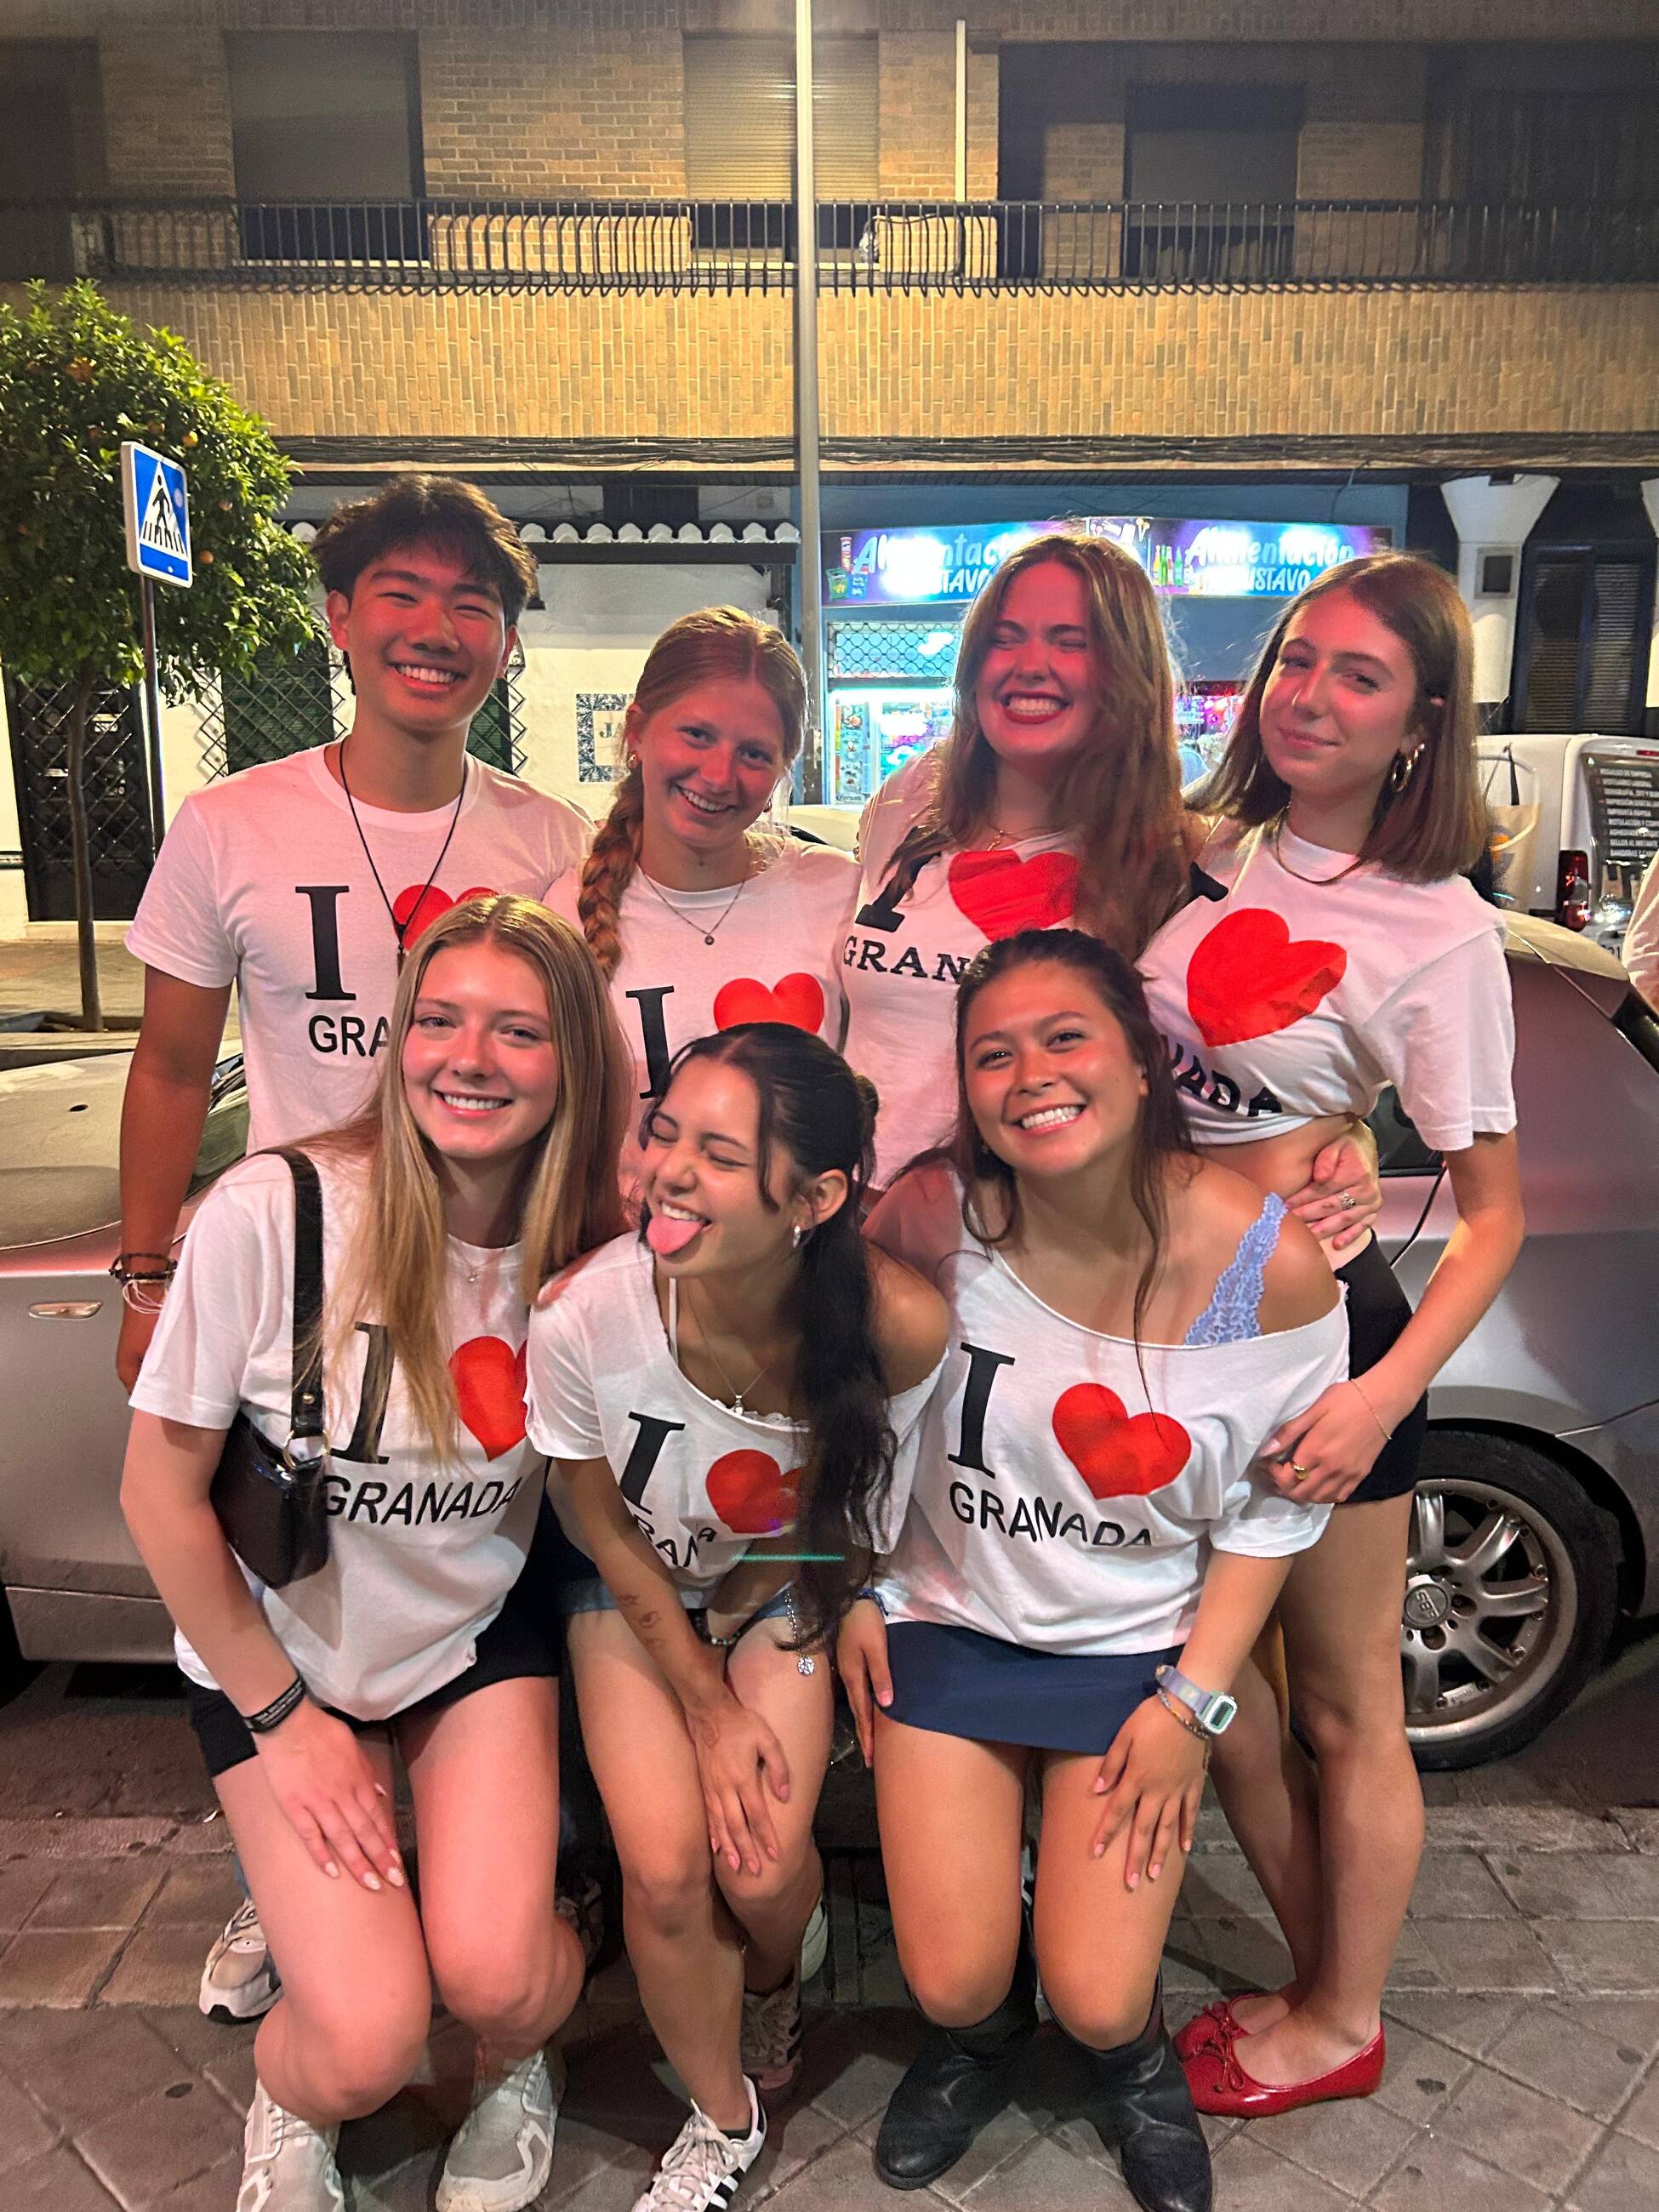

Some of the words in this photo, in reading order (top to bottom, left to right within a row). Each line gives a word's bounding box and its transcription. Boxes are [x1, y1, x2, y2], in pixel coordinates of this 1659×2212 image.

[855, 849, 941, 933] I
[295, 885, 356, 1001] I
[843, 936, 972, 985] GRAN
[309, 1015, 391, 1058] GRA
[625, 985, 675, 1099] I
[329, 1321, 396, 1465] I
[947, 1342, 1016, 1479] I
[323, 1475, 523, 1525] GRANADA
[619, 1411, 686, 1515] I
[949, 1481, 1152, 1548] GRANADA
